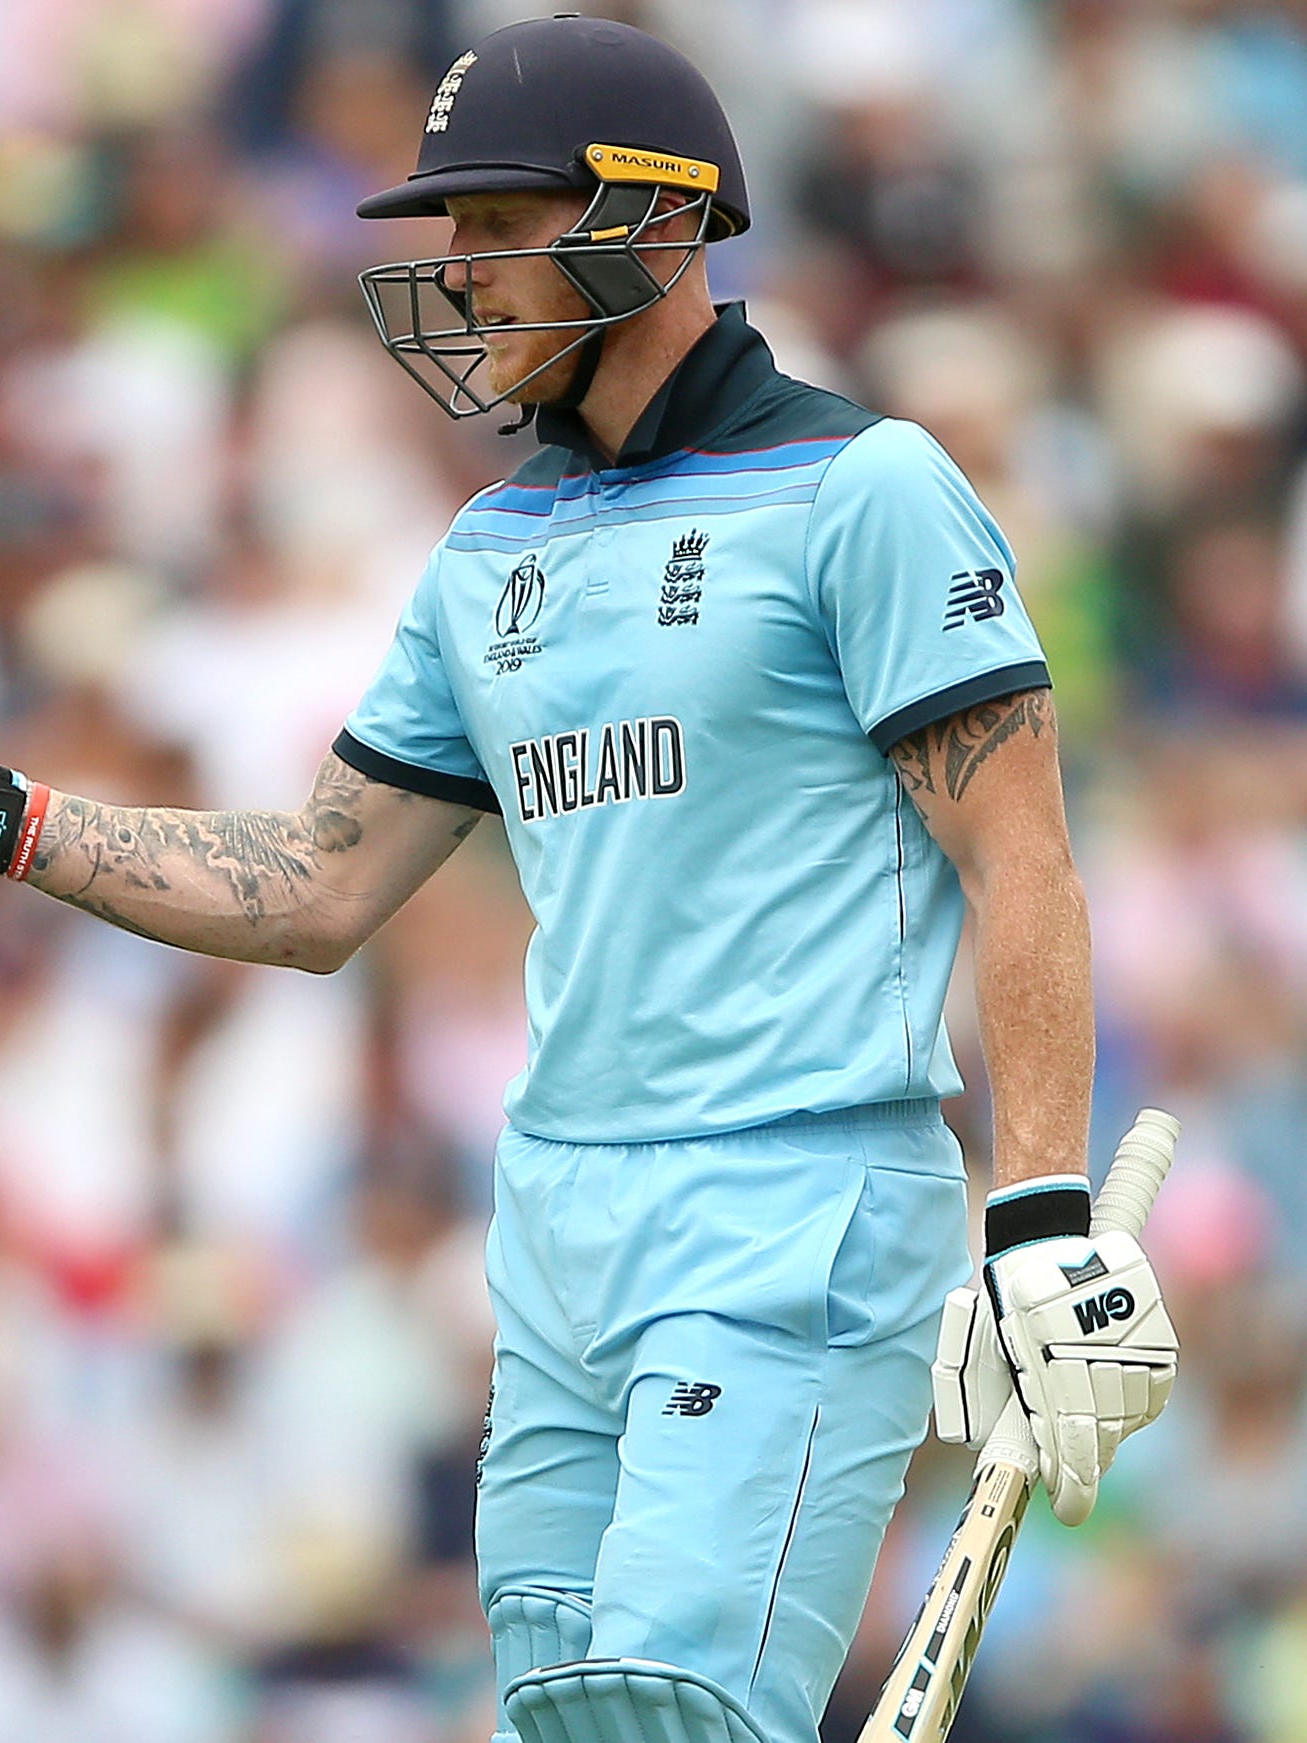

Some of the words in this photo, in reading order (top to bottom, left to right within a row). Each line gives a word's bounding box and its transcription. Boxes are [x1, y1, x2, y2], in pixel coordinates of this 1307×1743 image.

[612, 153, 681, 172] MASURI
[496, 658, 522, 675] 2019
[510, 714, 687, 824] ENGLAND
[27, 816, 39, 836] THE
[19, 836, 34, 864] RUTH
[1072, 1287, 1136, 1336] GM
[936, 1589, 960, 1633] DIAMOND
[901, 1687, 926, 1719] GM
